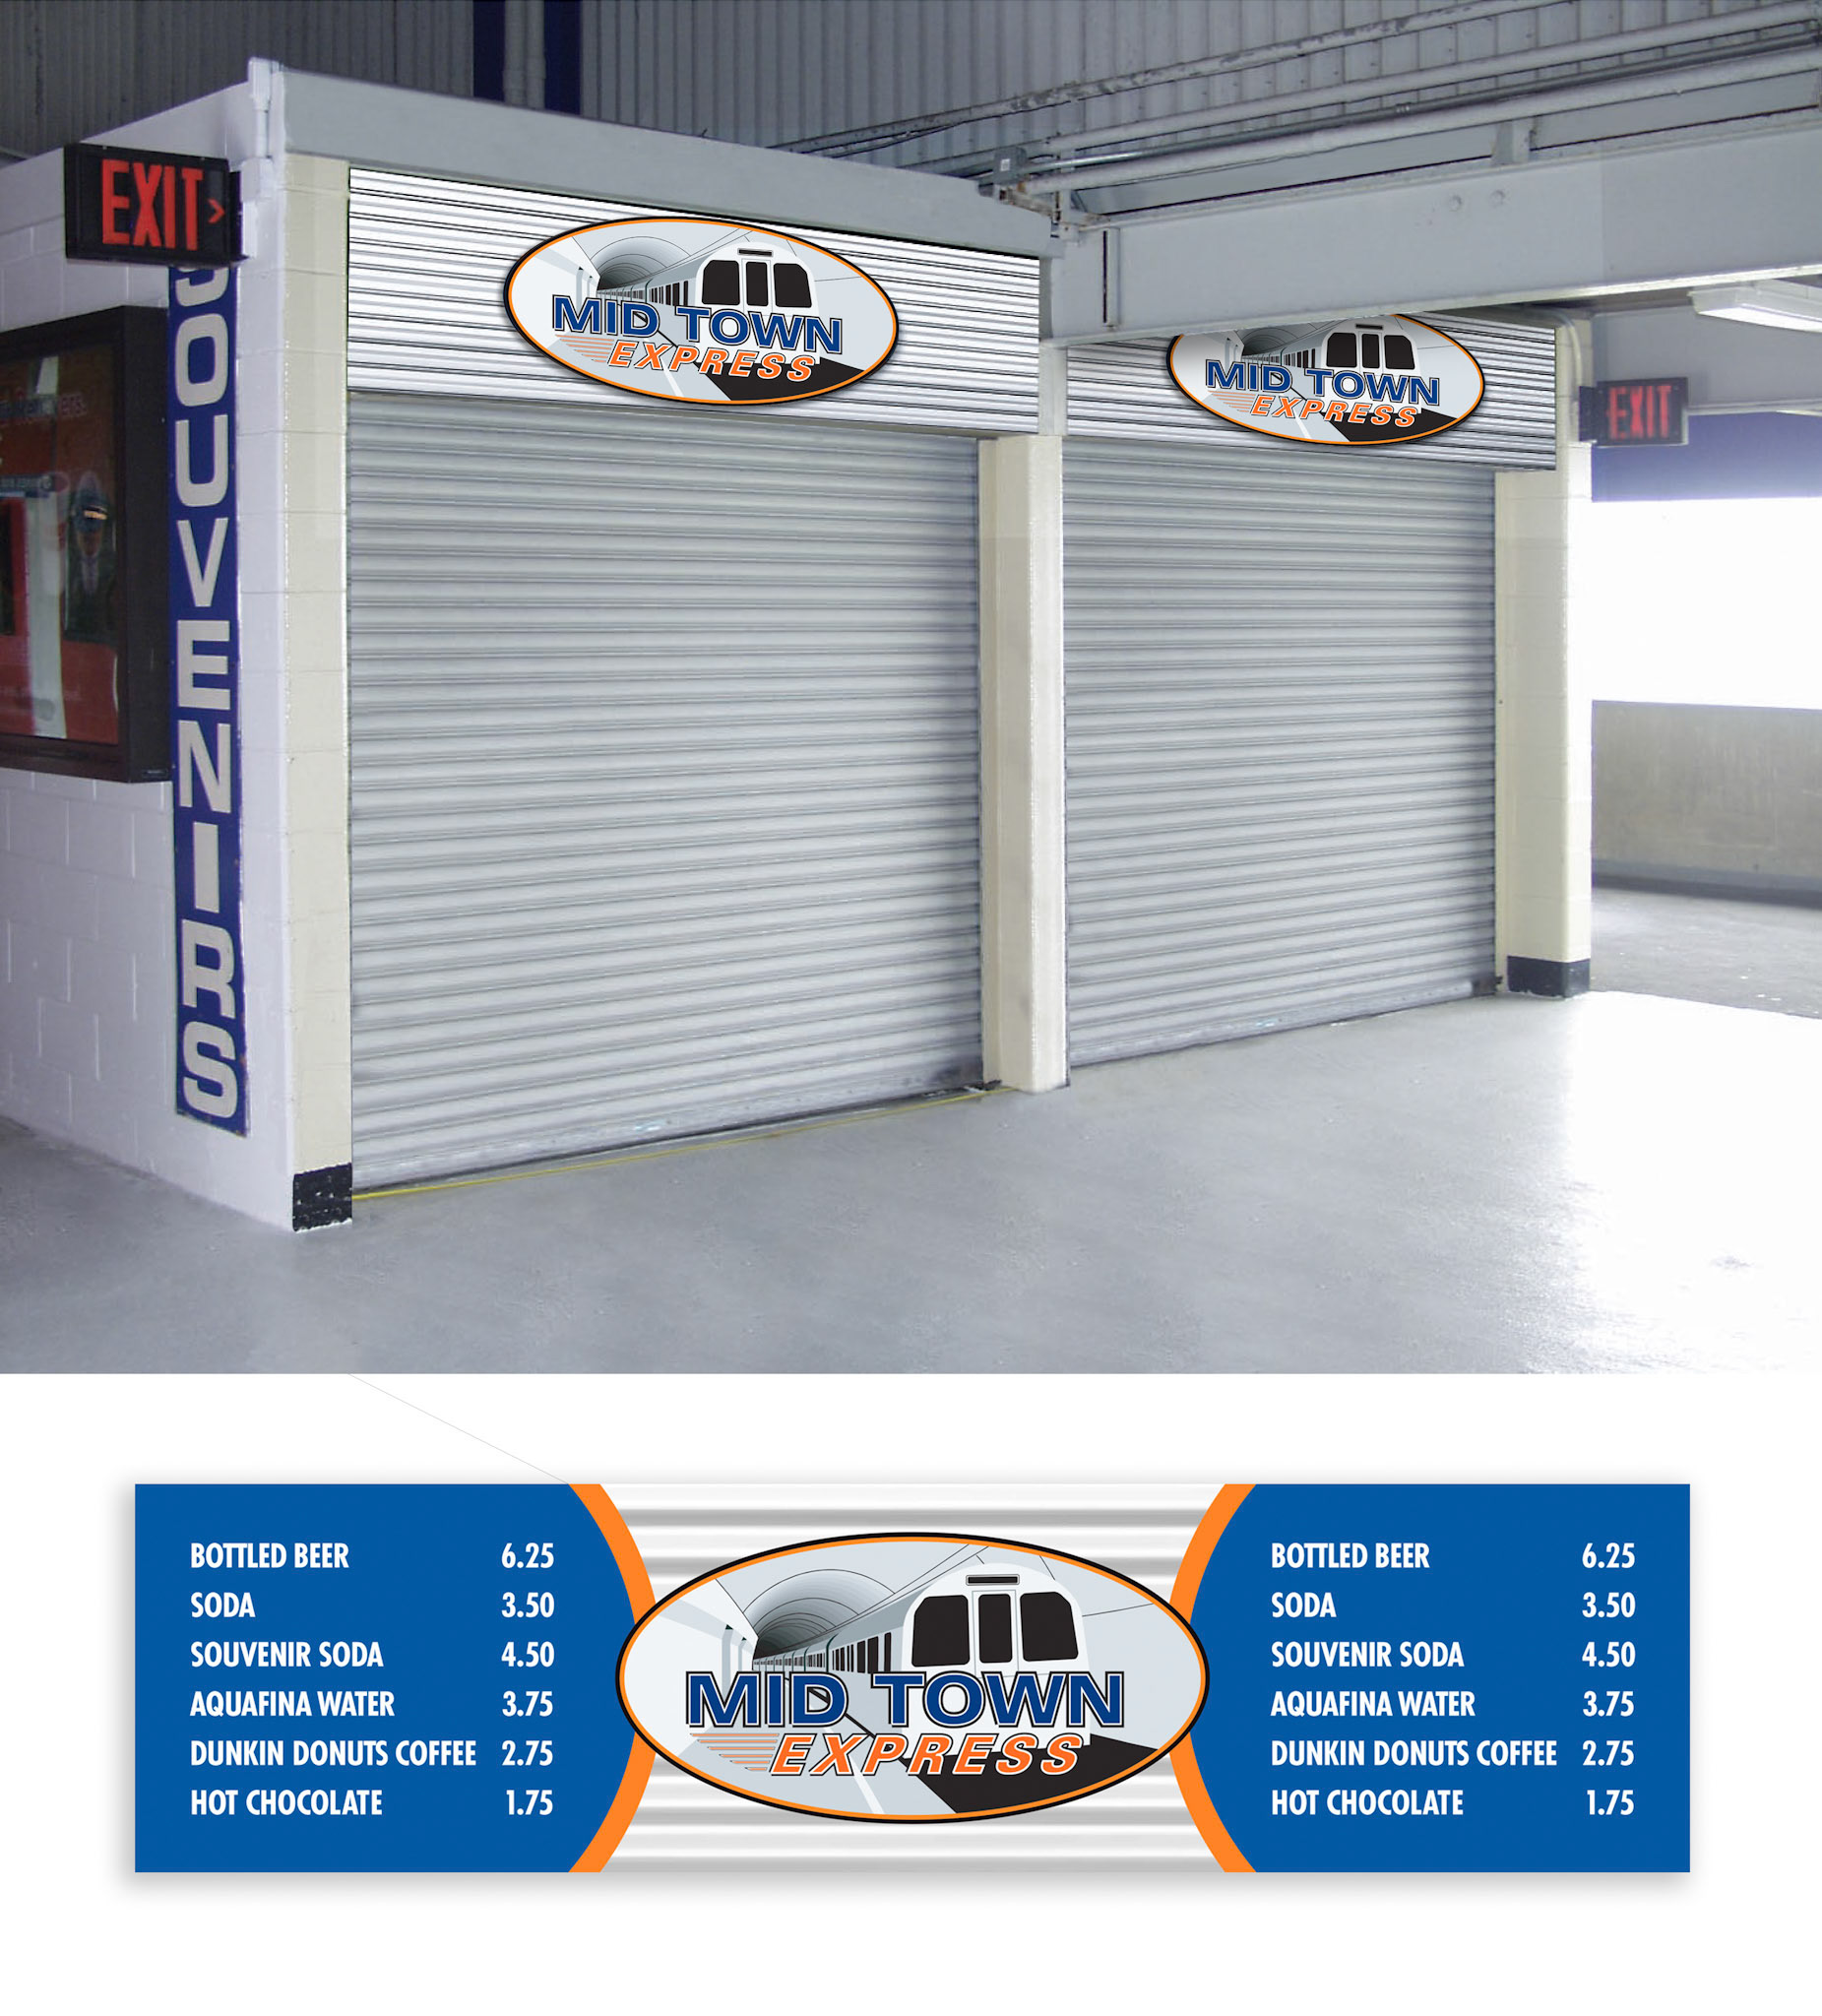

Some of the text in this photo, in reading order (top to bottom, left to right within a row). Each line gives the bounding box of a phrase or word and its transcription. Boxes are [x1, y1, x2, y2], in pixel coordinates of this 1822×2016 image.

[101, 158, 205, 251] EXIT
[551, 294, 843, 354] MID TOWN
[607, 340, 817, 382] EXPRESS
[1205, 359, 1440, 407] MID TOWN
[1250, 395, 1418, 428] EXPRESS
[1606, 384, 1672, 440] EXIT
[190, 1542, 554, 1569] BOTTLED BEER 6.25
[1271, 1542, 1636, 1569] BOTTLED BEER 6.25
[190, 1591, 555, 1618] SODA 3.50
[1271, 1591, 1636, 1618] SODA 3.50
[190, 1641, 555, 1668] SOUVENIR SODA 4.50
[1271, 1641, 1636, 1668] SOUVENIR SODA 4.50
[189, 1690, 553, 1718] AQUAFINA WATER 3.75
[685, 1670, 1125, 1728] MID TOWN
[1270, 1690, 1635, 1718] AQUAFINA WATER 3.75
[190, 1739, 553, 1767] DUNKIN DONUTS COFFEE 2.75
[770, 1732, 1086, 1777] EXPRESS
[1271, 1739, 1635, 1767] DUNKIN DONUTS COFFEE 2.75
[191, 1789, 553, 1816] HOT CHOCOLATE 1.75
[1272, 1789, 1635, 1816] HOT CHOCOLATE 1.75
